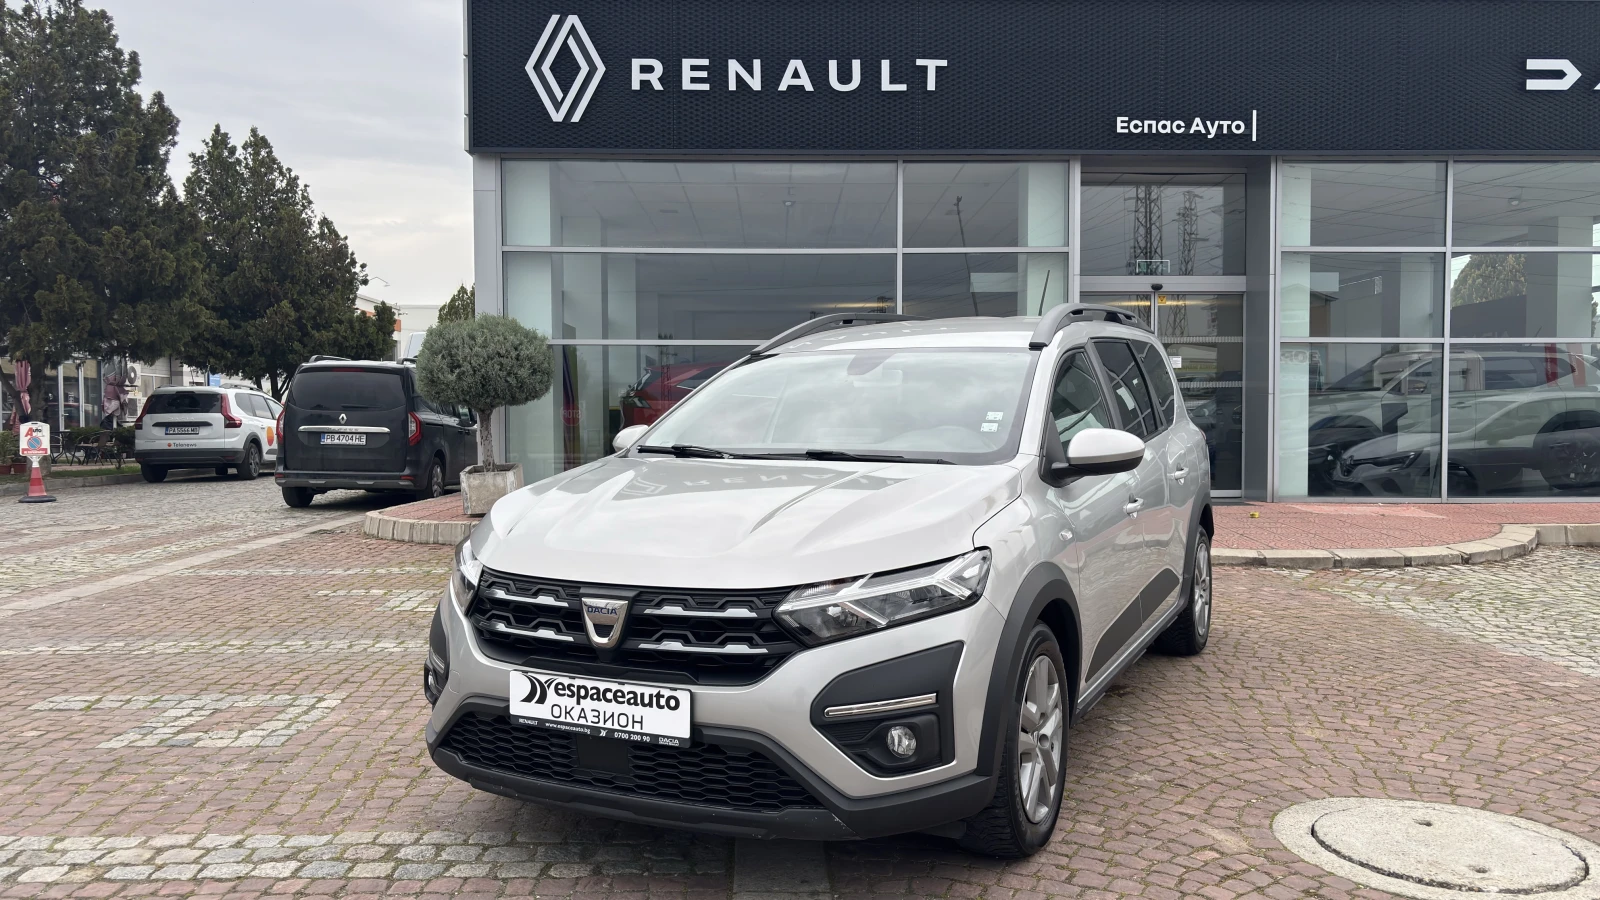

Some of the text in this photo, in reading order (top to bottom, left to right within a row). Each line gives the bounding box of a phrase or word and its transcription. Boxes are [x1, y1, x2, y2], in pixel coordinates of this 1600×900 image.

[631, 58, 948, 92] RENAULT
[1116, 116, 1245, 139] Еспас Ауто
[326, 434, 365, 443] PB 4704 HE
[587, 605, 618, 616] DACIA
[554, 681, 680, 711] espaceauto
[551, 703, 644, 731] ОКАЗИОН
[518, 718, 591, 734] RENAULT www.espaceauto.bg
[614, 732, 629, 740] 0700
[630, 733, 642, 742] 200
[658, 737, 680, 745] DACIA
